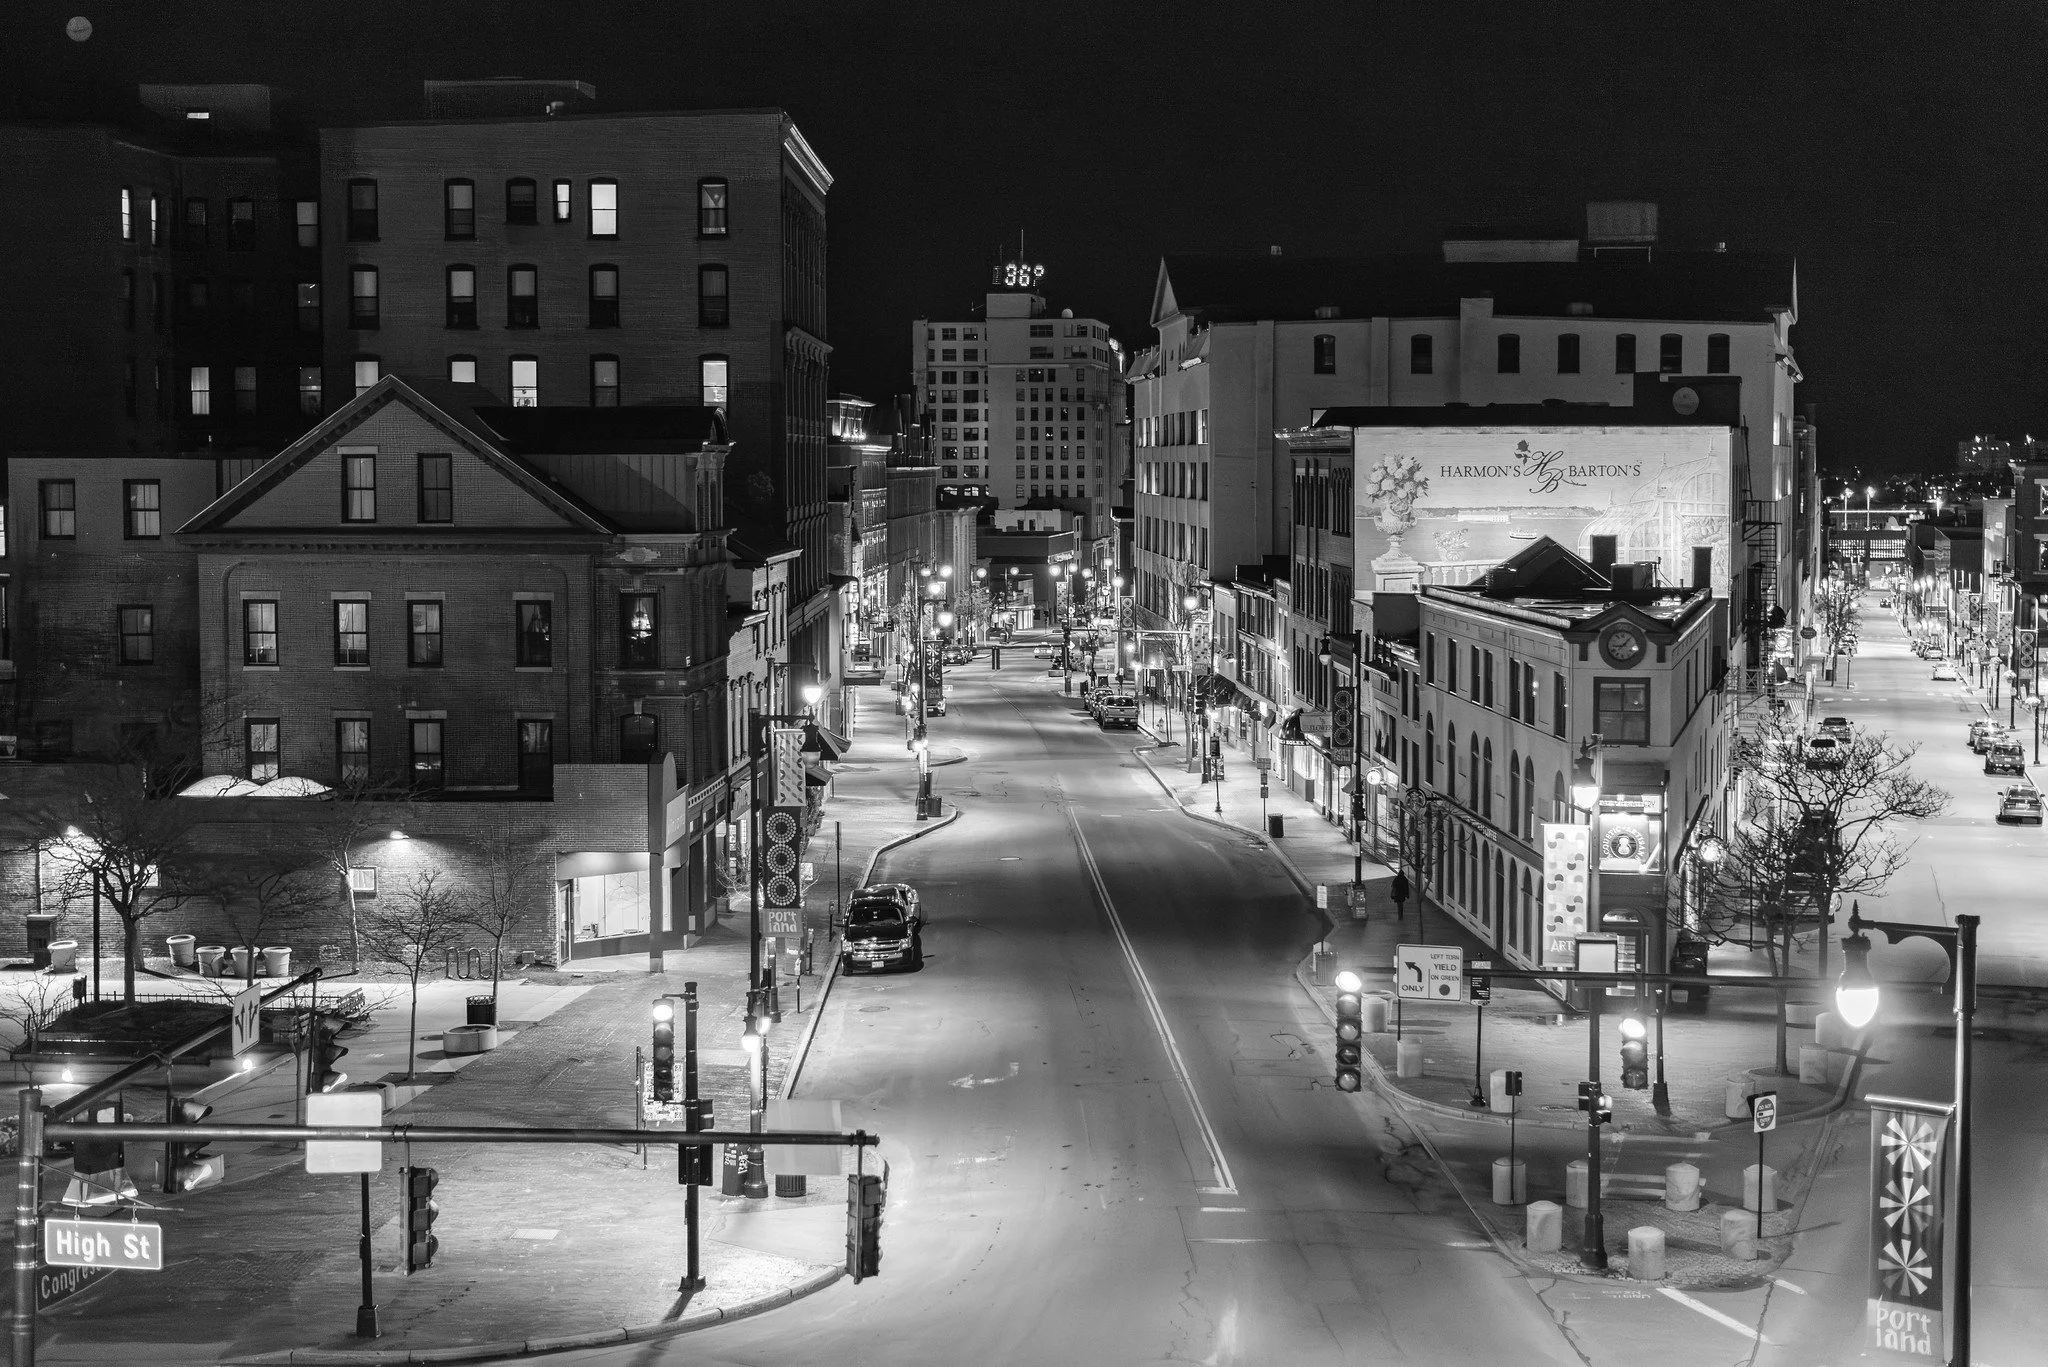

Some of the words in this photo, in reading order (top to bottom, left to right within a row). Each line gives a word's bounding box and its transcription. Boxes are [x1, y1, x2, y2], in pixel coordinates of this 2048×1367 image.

[1440, 465, 1521, 478] HARMON'S
[1569, 464, 1641, 477] BARTON'S
[849, 581, 859, 645] EMPIRE
[1433, 963, 1457, 972] YIELD
[1440, 974, 1460, 982] GREEN
[1401, 984, 1425, 992] ONLY
[56, 1230, 111, 1263] High
[123, 1233, 151, 1260] St
